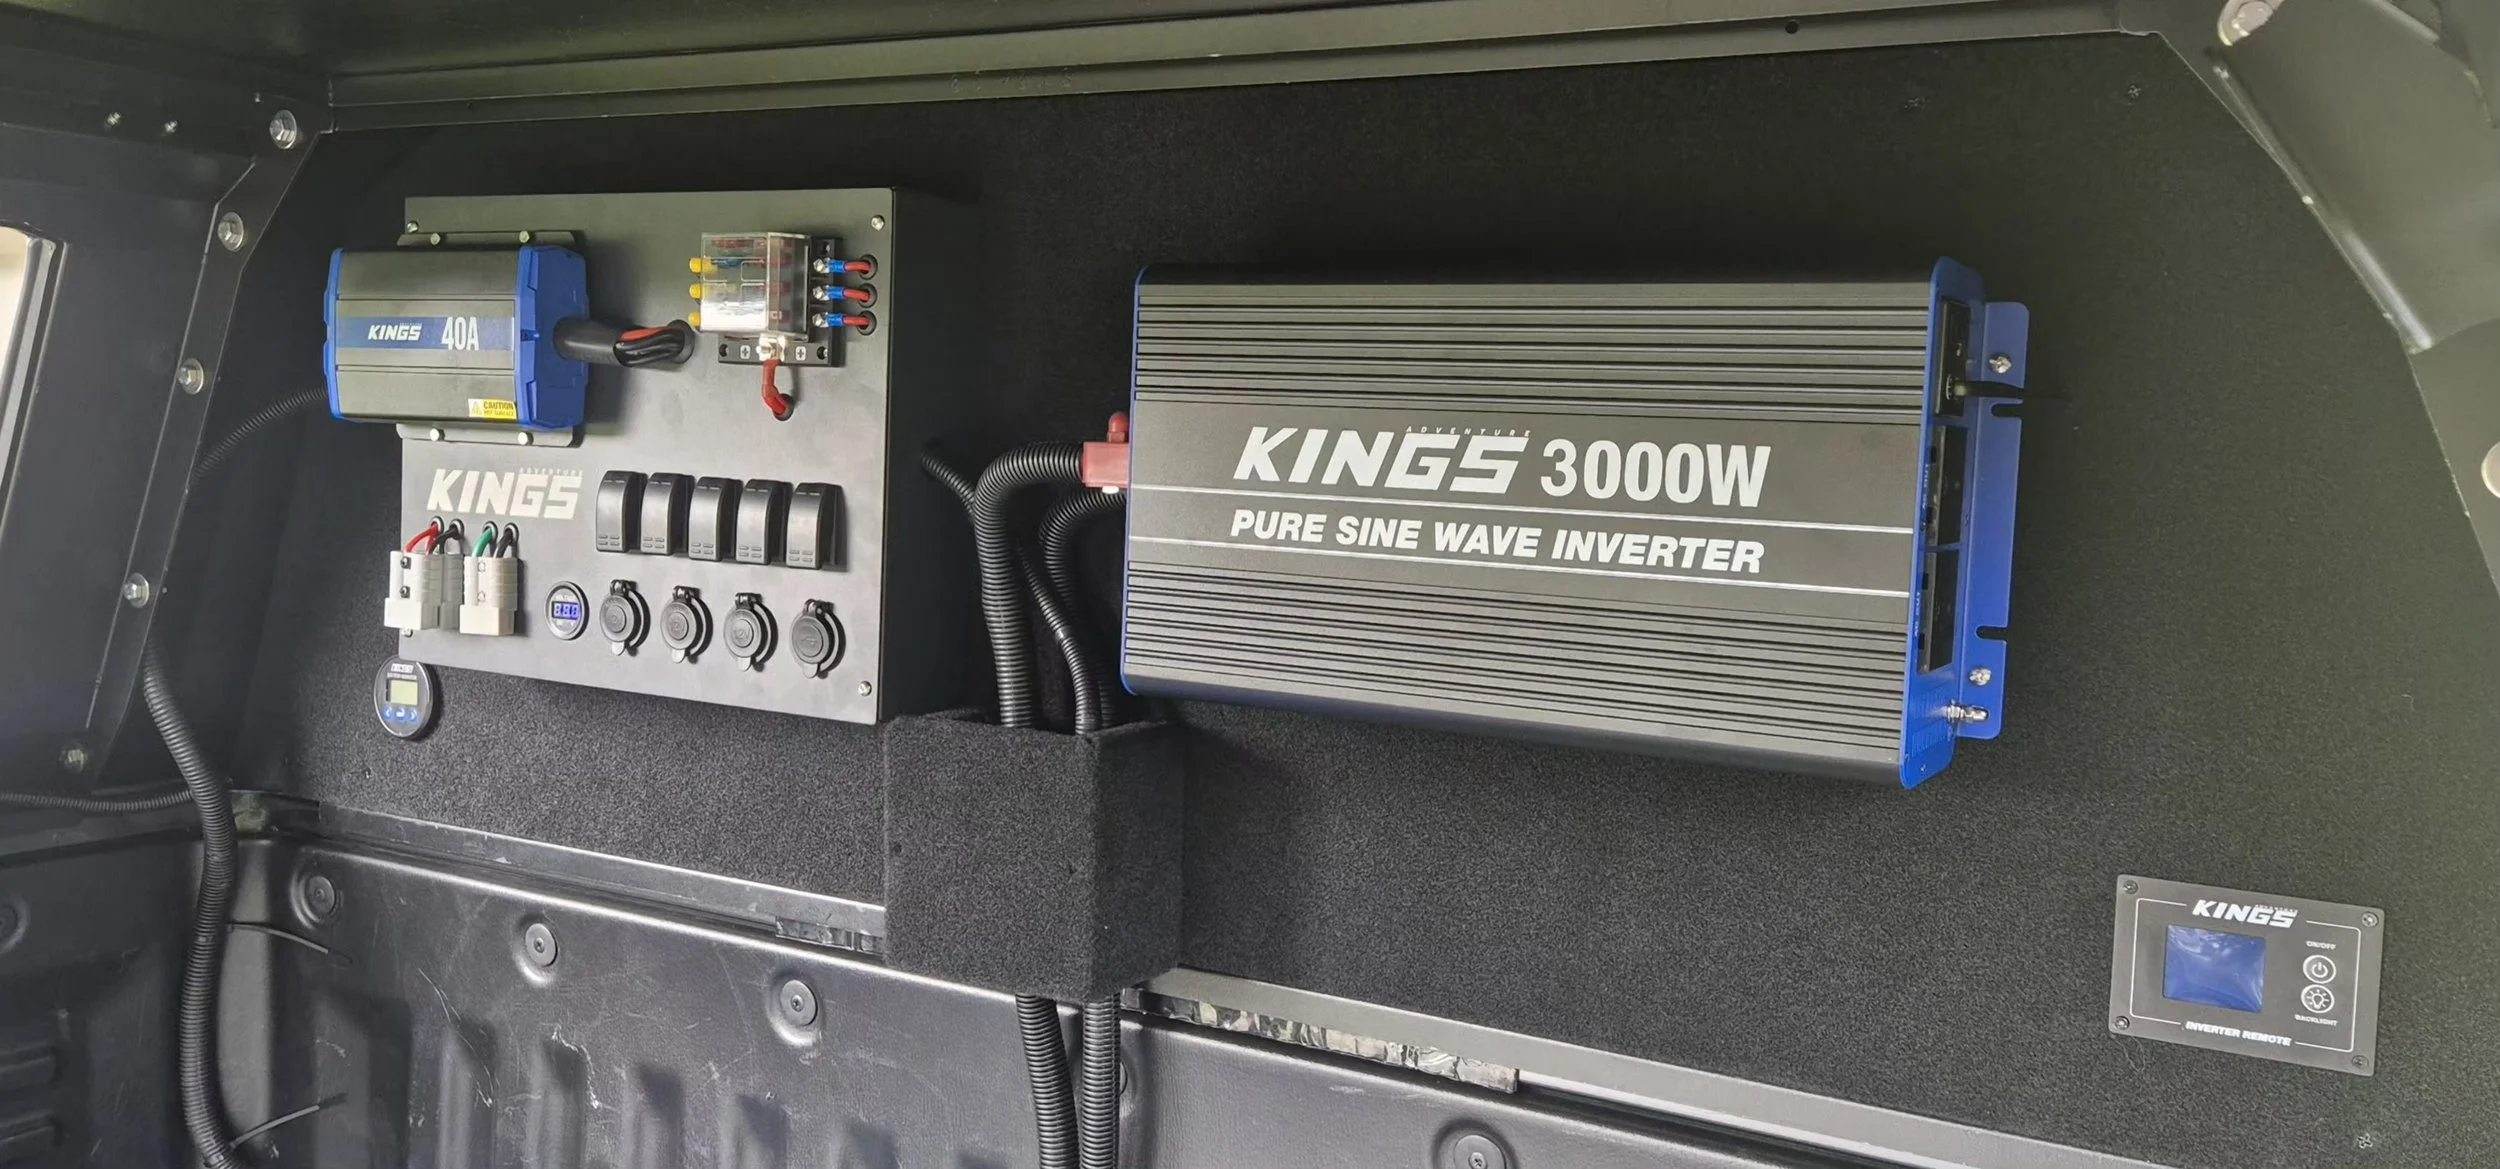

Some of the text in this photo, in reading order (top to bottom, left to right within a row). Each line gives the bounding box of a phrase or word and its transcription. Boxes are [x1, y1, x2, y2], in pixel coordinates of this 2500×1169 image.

[367, 316, 480, 351] KINGS 40A
[483, 401, 514, 410] CAUTION
[1406, 426, 1531, 438] ADVENTURE
[1233, 427, 1772, 507] KINGS 3000W
[427, 468, 582, 520] KINGS
[1230, 509, 1765, 573] PURE SINE WAVE INVERTER
[2192, 899, 2298, 929] KINGS
[2306, 940, 2336, 950] ON/OFF
[2185, 1020, 2292, 1046] INVERTER REMOTE
[2294, 1014, 2338, 1026] BACKLIGHT
